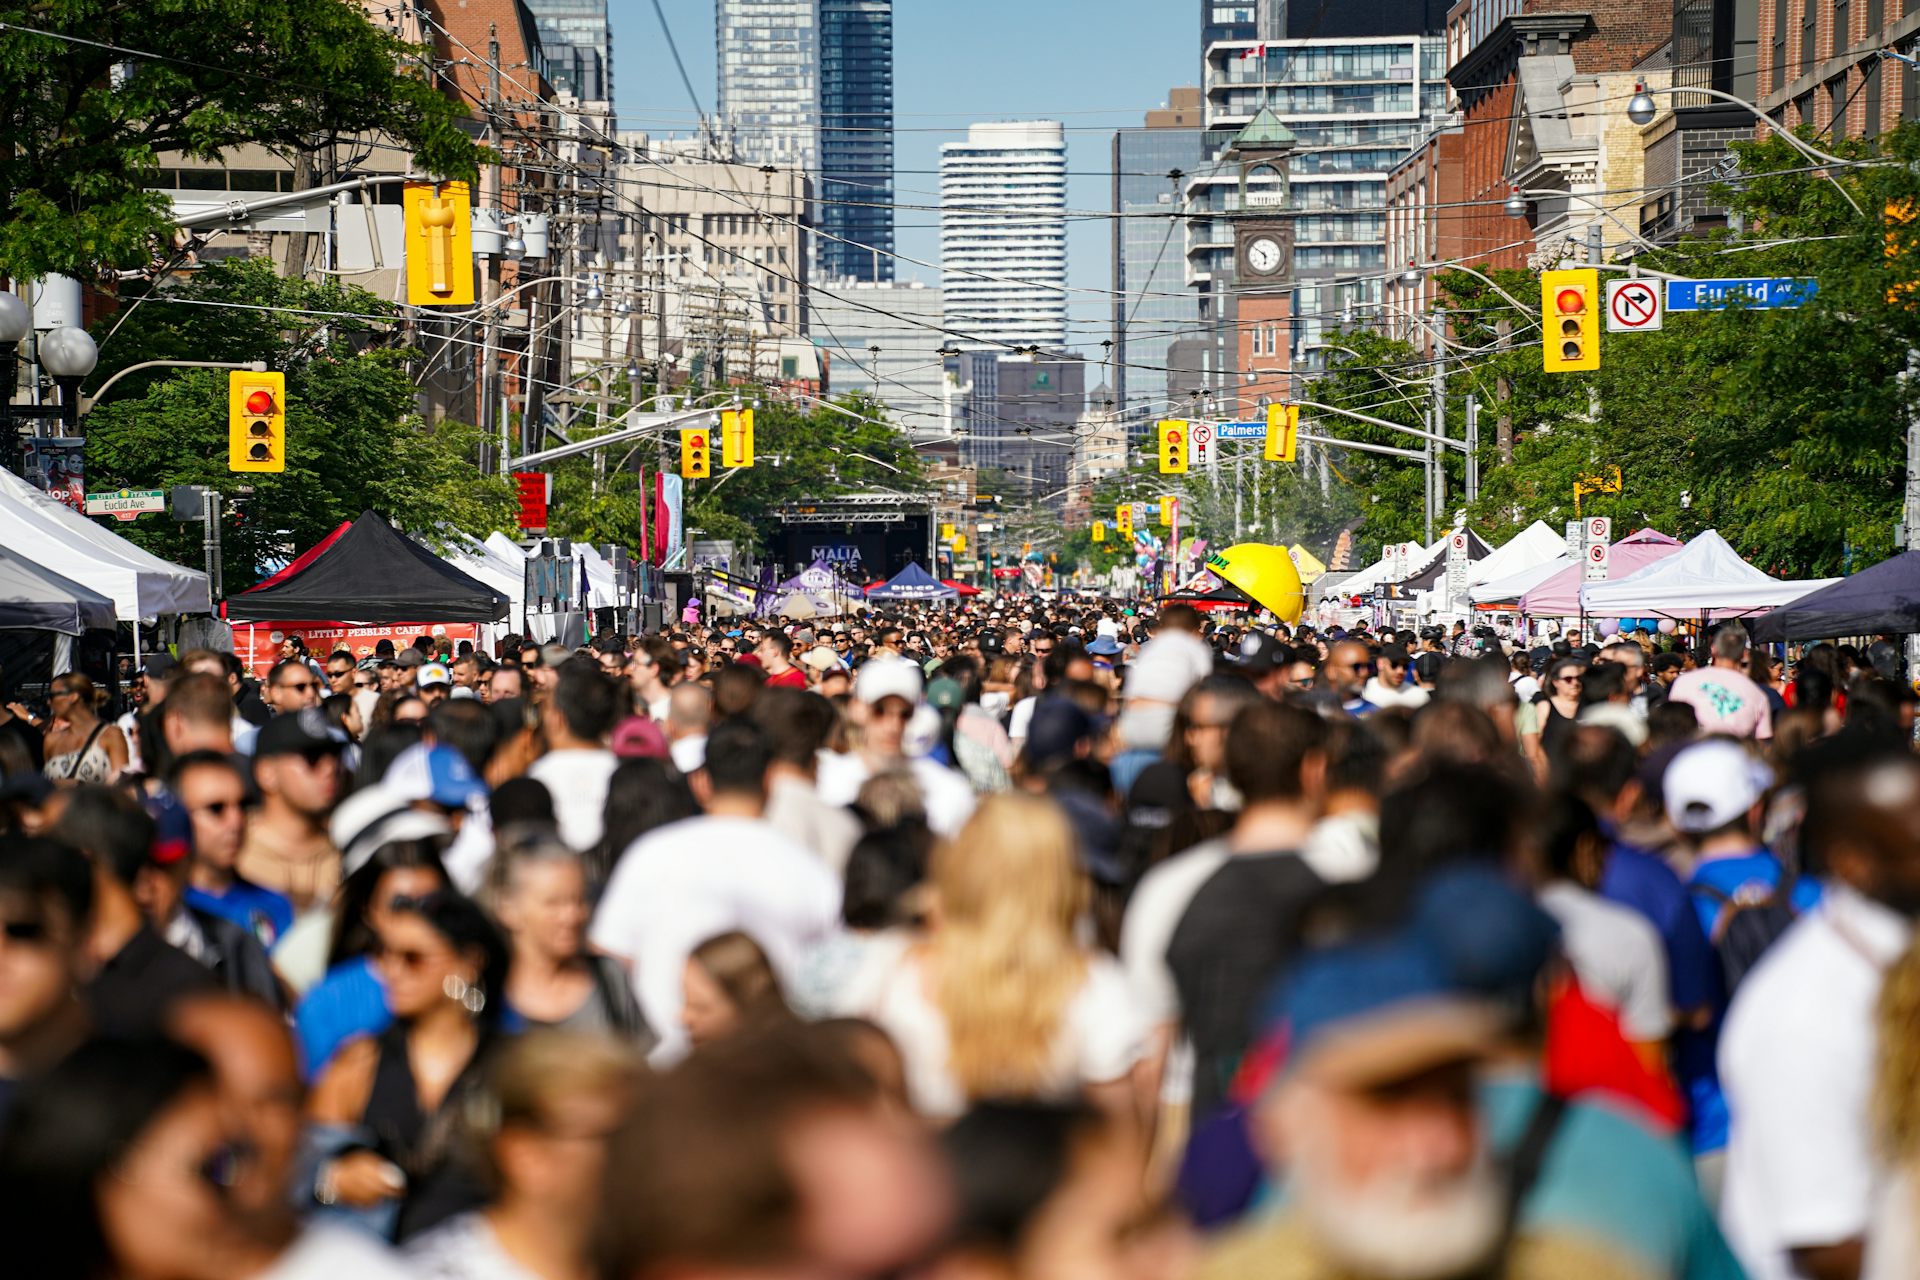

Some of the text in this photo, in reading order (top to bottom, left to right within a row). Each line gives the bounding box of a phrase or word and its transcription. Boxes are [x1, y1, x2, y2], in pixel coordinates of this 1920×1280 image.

[1776, 284, 1793, 293] Av
[104, 499, 145, 511] Euclid Ave
[811, 548, 862, 560] MALIA
[308, 629, 344, 639] LITTLE
[347, 627, 392, 637] PEBBLES
